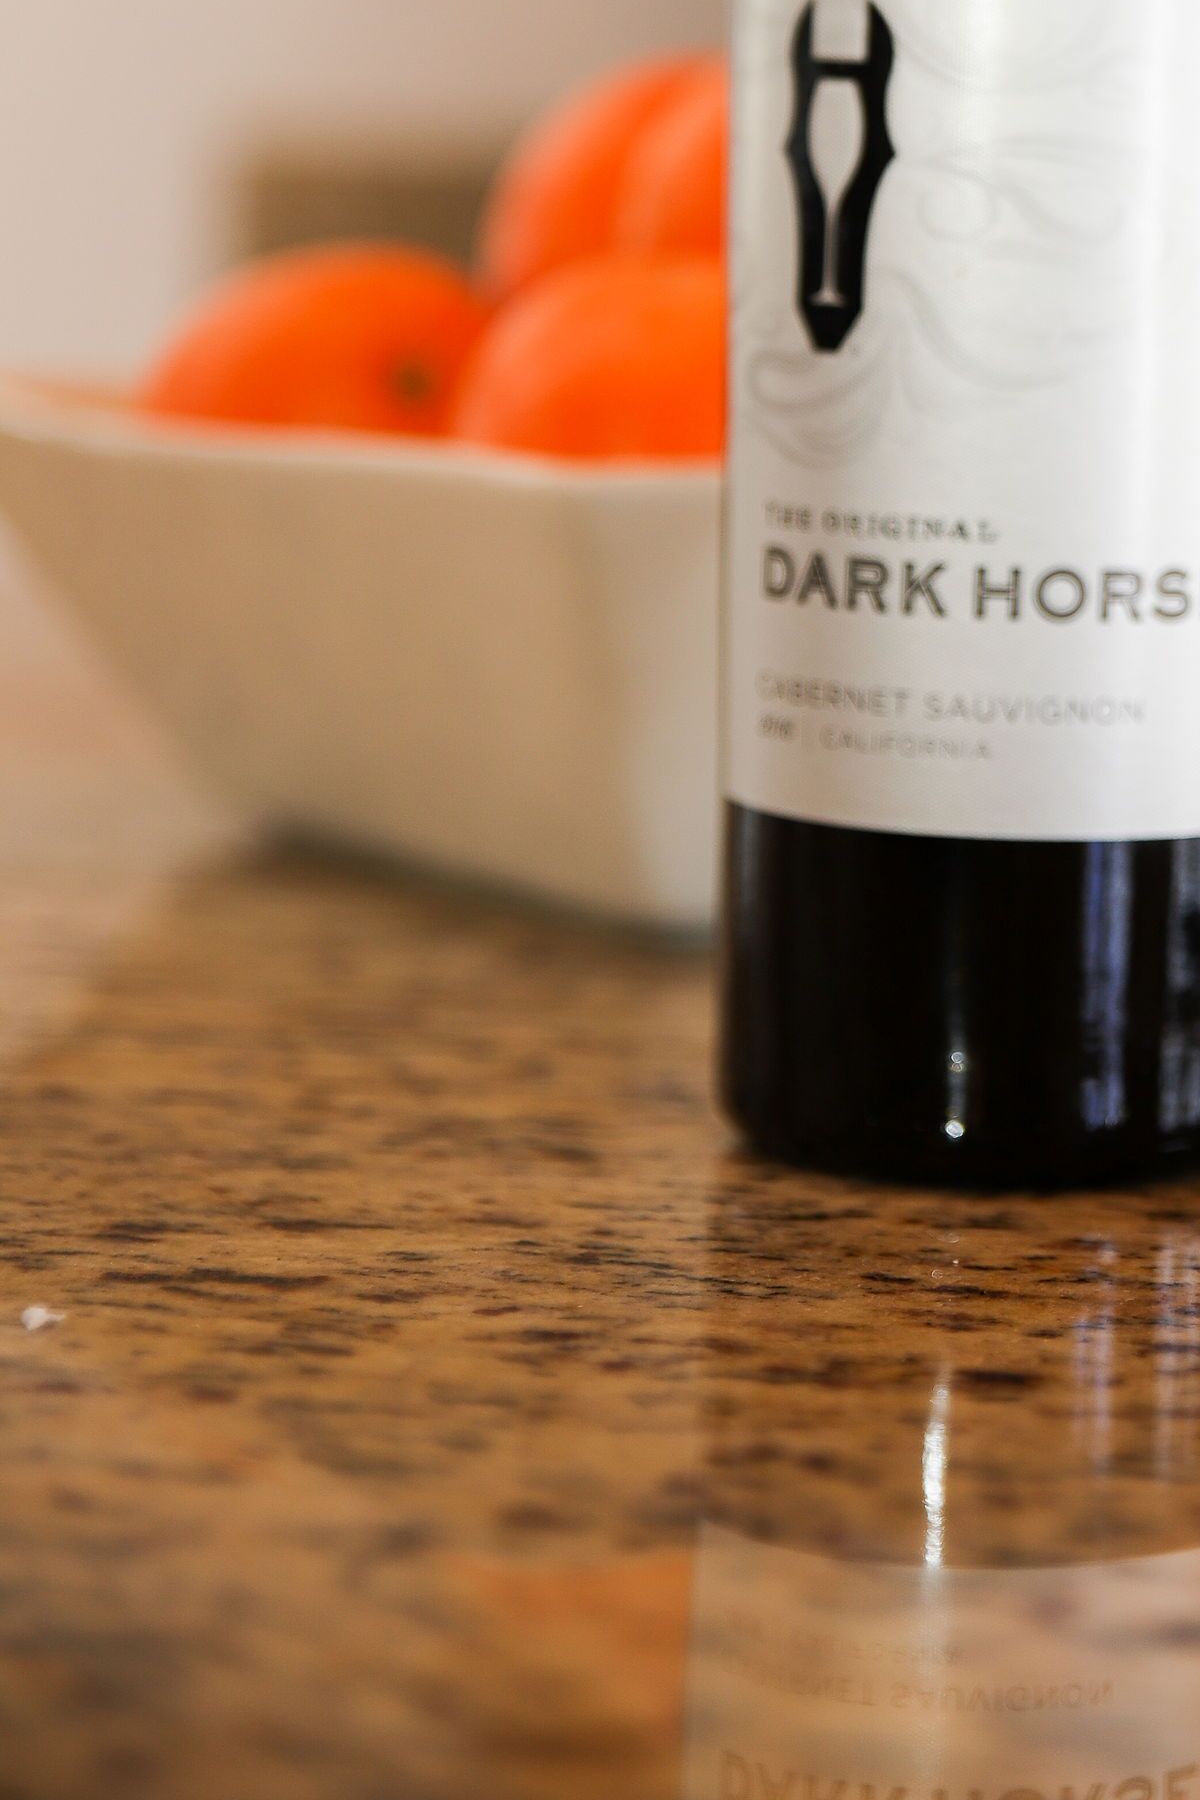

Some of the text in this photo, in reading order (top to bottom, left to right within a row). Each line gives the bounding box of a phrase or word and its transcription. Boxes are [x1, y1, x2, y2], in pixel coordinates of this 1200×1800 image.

[763, 500, 998, 544] THE ORIGINAL
[762, 545, 948, 617] DARK
[755, 667, 1146, 726] CABERNET SAUVIGNON
[819, 723, 993, 760] CALIFORNIA
